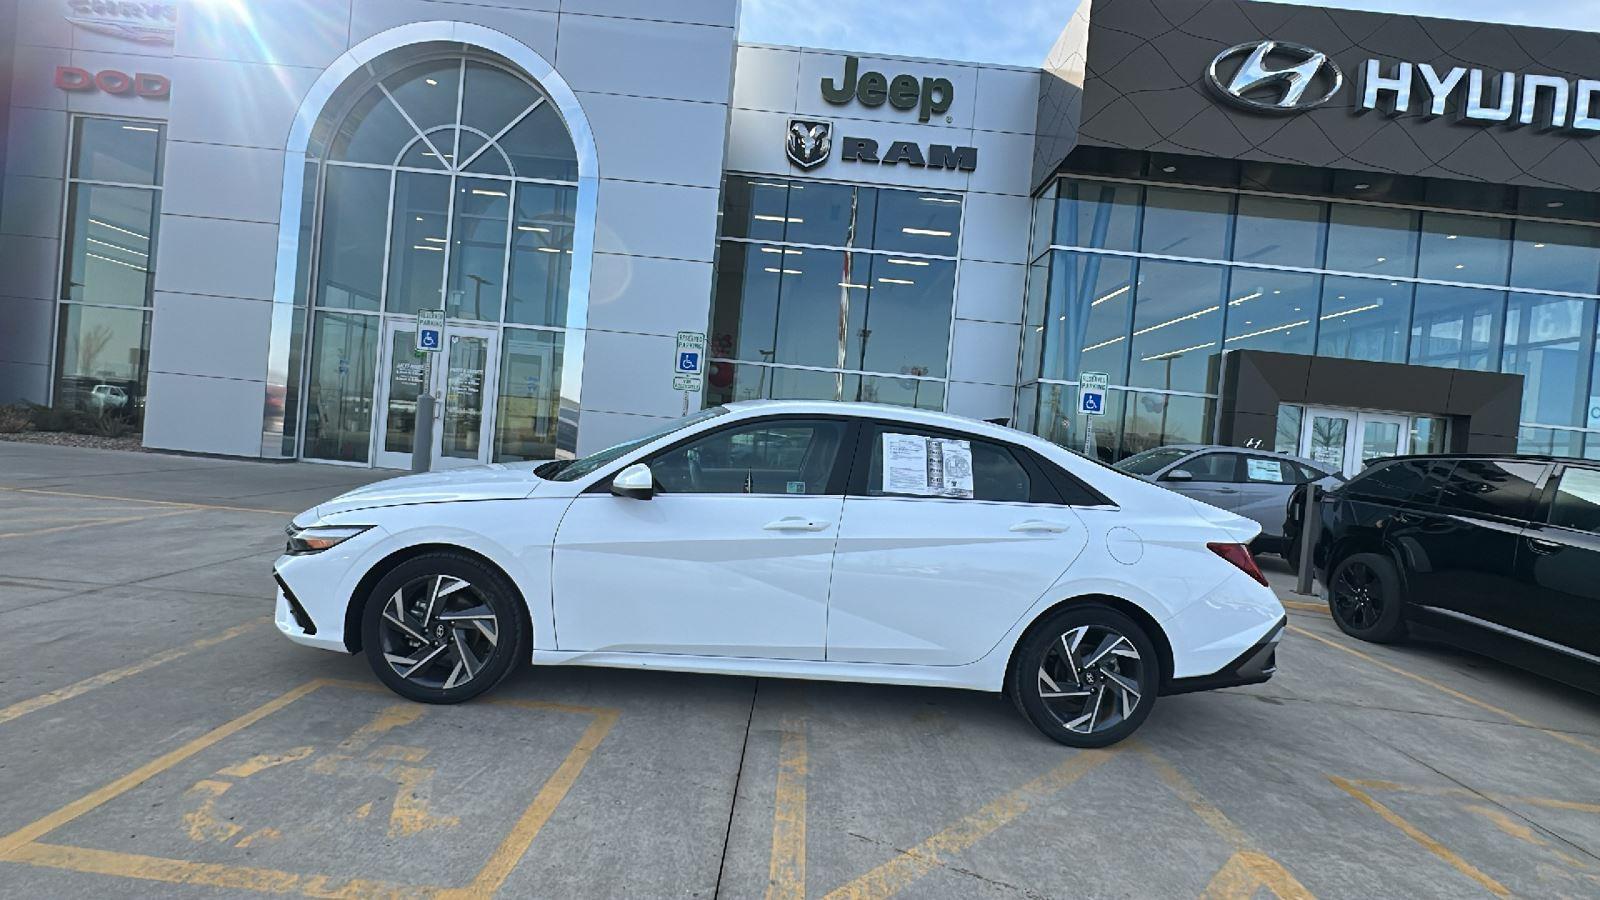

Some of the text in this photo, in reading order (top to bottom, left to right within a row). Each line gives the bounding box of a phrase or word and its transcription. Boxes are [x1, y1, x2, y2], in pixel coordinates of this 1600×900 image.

[55, 65, 171, 97] DOD
[821, 56, 954, 122] Jeep
[842, 136, 977, 171] RAM
[419, 319, 443, 327] PARKING
[678, 341, 702, 350] PARKING
[1080, 383, 1106, 391] PARKING
